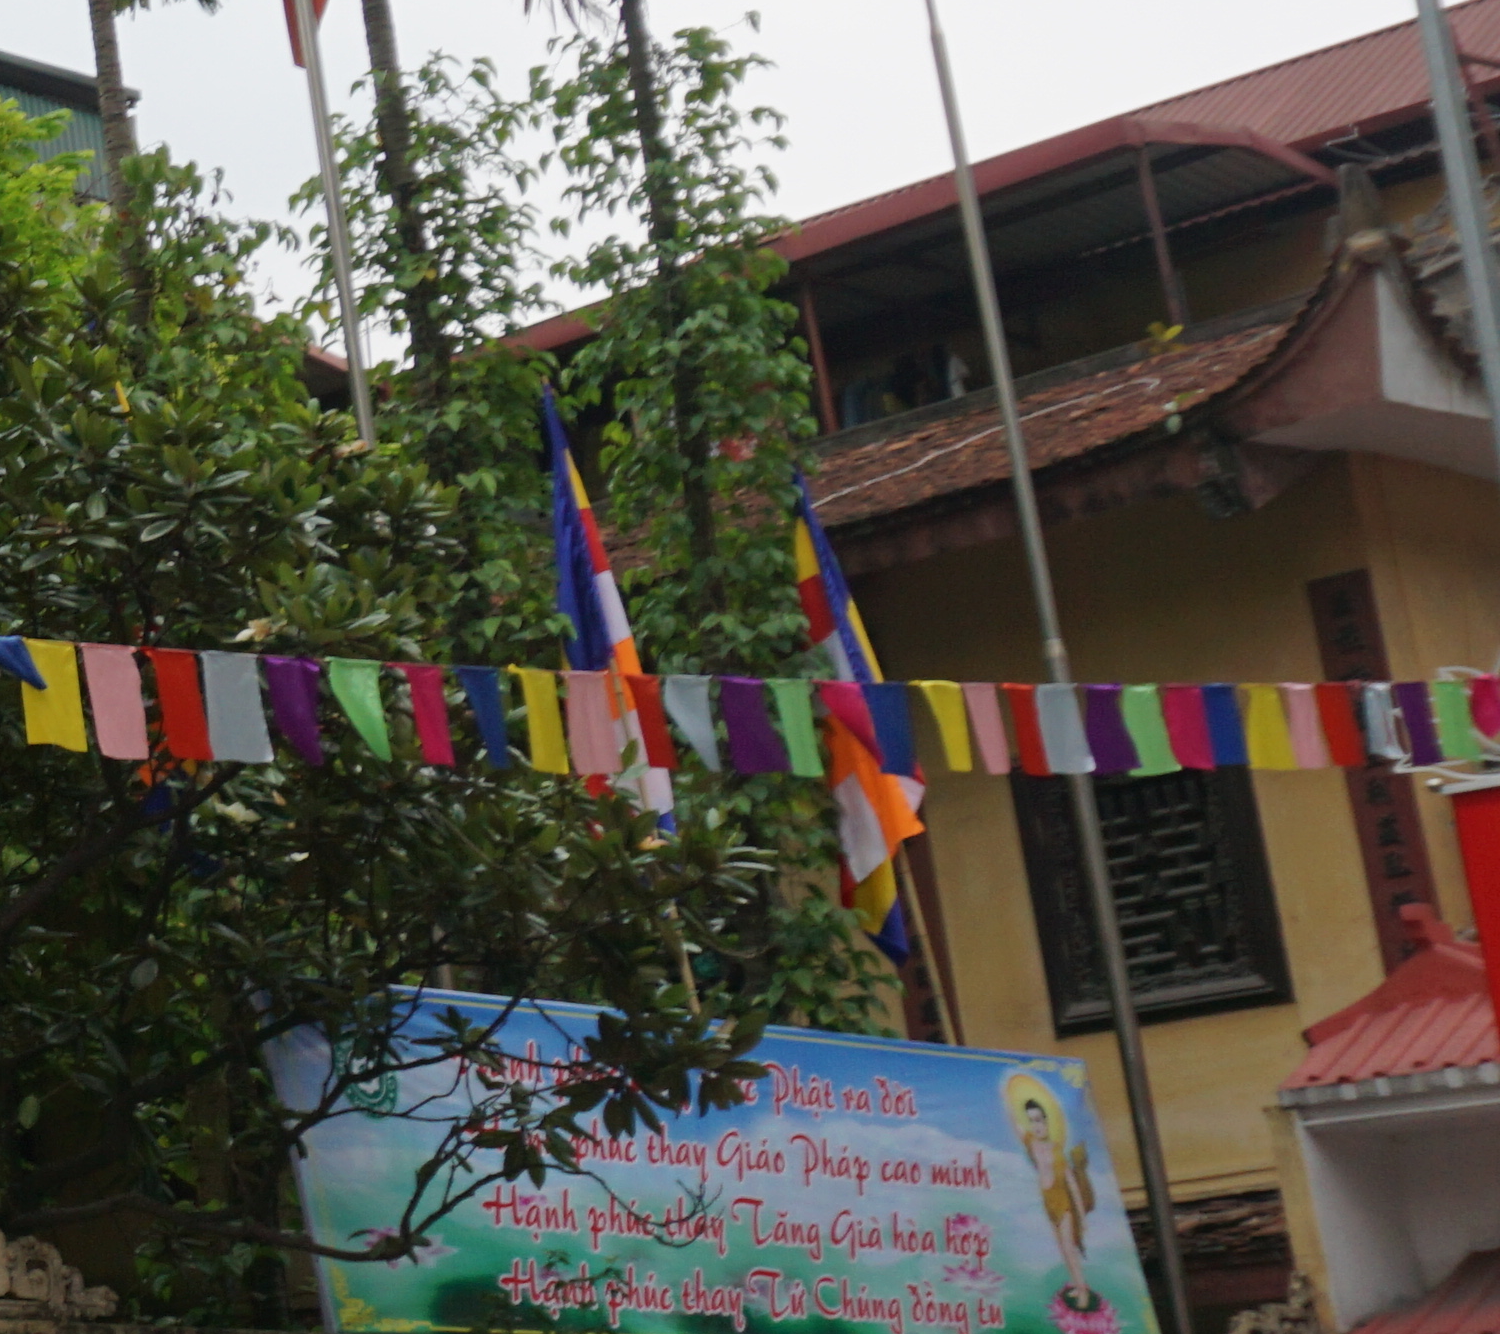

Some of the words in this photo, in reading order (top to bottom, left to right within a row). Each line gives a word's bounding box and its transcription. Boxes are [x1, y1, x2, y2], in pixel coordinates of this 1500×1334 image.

[842, 1087, 872, 1114] ra
[715, 1128, 786, 1183] Giáo
[789, 1133, 871, 1197] Pháp
[879, 1158, 922, 1186] cao
[929, 1150, 992, 1191] minh
[481, 1184, 580, 1242] Hạnh
[730, 1196, 821, 1261] Tăng
[891, 1212, 936, 1253] hòa
[681, 1267, 745, 1333] thay
[975, 1297, 1004, 1327] tu
